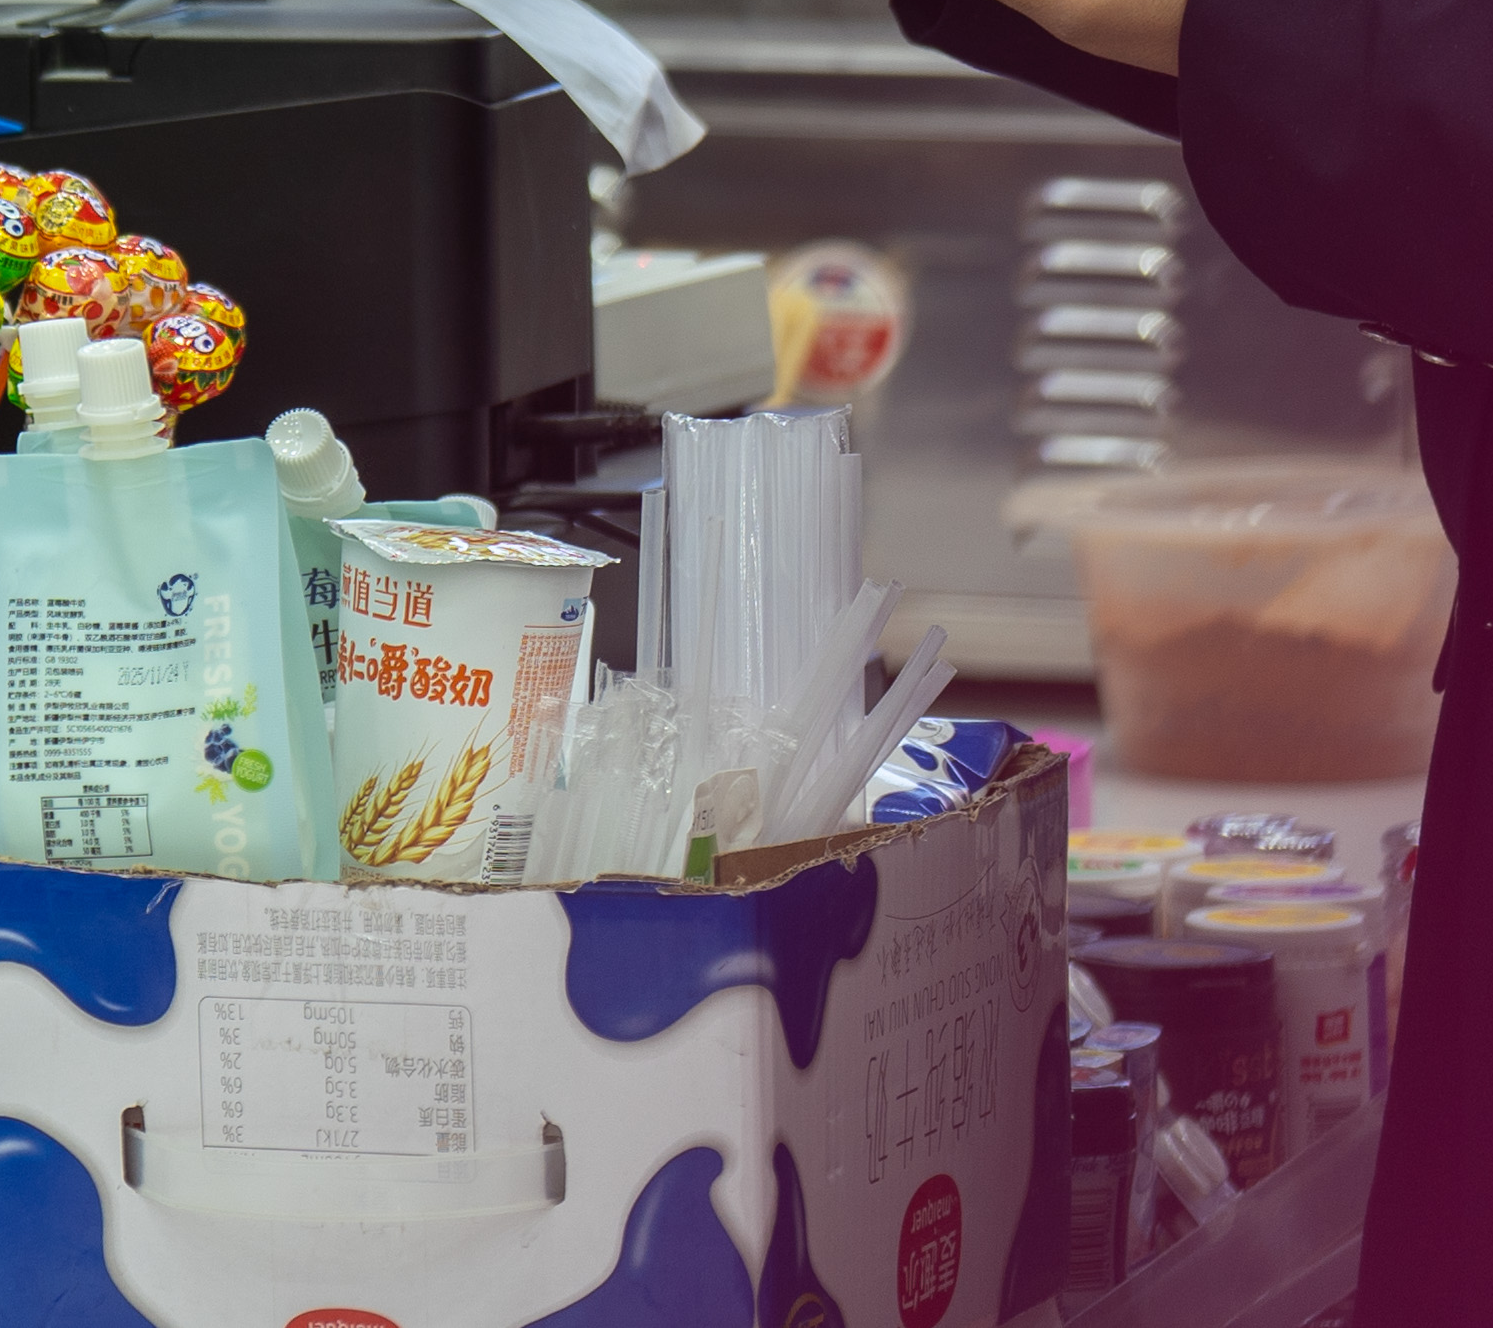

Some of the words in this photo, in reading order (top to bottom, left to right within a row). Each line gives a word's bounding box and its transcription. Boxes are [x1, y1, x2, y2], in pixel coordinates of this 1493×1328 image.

[237, 755, 266, 773] FRESH
[234, 765, 269, 786] YOGURT
[976, 951, 1005, 994] NONG
[949, 967, 972, 1005] SUO
[913, 979, 946, 1021] CHUN
[214, 1002, 244, 1020] 13%
[303, 1002, 355, 1024] 105mg
[448, 1009, 464, 1029] 钙
[888, 995, 910, 1033] NIU
[219, 1027, 240, 1044] 3%
[863, 1007, 886, 1044] NAI
[313, 1027, 356, 1048] 50mg
[449, 1033, 464, 1052] 钠
[220, 1052, 241, 1069] 2%
[324, 1052, 356, 1073] 5.0g
[385, 1057, 465, 1078] 碳水化合物
[221, 1076, 242, 1093] 6%
[325, 1077, 357, 1098] 3.5g
[434, 1082, 466, 1103] 脂肪
[222, 1100, 243, 1118] 6%
[326, 1102, 358, 1122] 3.3g
[418, 1106, 467, 1127] 蛋白质
[223, 1125, 243, 1143] 3%
[316, 1128, 359, 1147] 271kJ
[435, 1131, 467, 1153] 能量
[910, 1195, 953, 1235] maiquer
[901, 1228, 957, 1307] 麦趣尔
